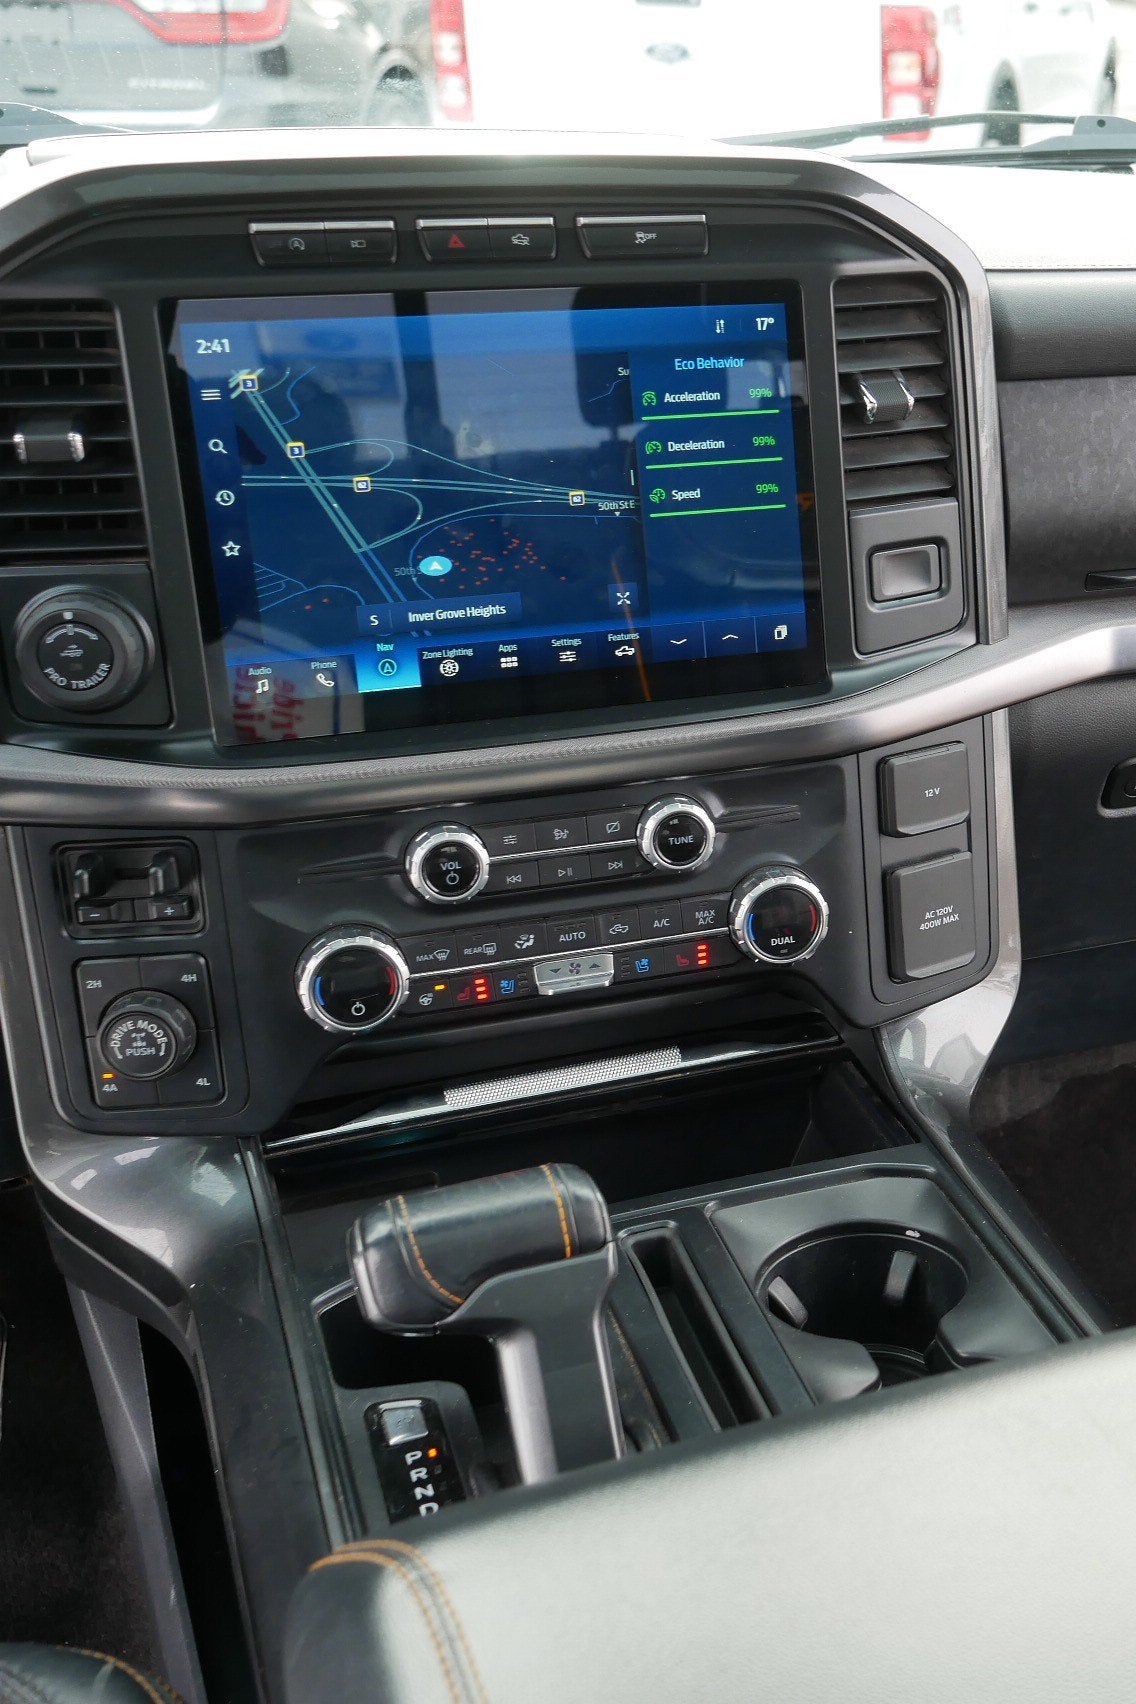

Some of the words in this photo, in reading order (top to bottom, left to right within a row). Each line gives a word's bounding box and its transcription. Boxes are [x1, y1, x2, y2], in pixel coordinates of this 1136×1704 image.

[195, 338, 231, 354] 2:41
[673, 358, 695, 370] Eco
[696, 356, 745, 370] Behavior
[663, 390, 721, 403] Acceleration
[749, 388, 773, 399] 99%
[667, 439, 726, 452] Deceleration
[752, 436, 777, 447] 99%
[756, 483, 779, 494] 99%
[672, 488, 701, 502] Speed
[598, 501, 618, 511] 50th
[619, 500, 630, 510] St
[630, 500, 636, 509] E
[394, 566, 416, 576] 50th
[408, 611, 435, 622] Inver
[435, 608, 466, 620] Grove
[466, 604, 507, 618] Heights
[370, 614, 379, 626] S
[551, 636, 582, 648] Settings
[607, 631, 640, 642] Features
[376, 643, 395, 652] Nav
[498, 644, 518, 654] Apps
[422, 650, 442, 660] Zone
[443, 647, 474, 658] Lighting
[310, 660, 338, 670] Phone
[44, 667, 67, 686] PRO
[70, 663, 111, 689] TRAILER
[248, 667, 273, 677] Audio
[924, 788, 934, 798] 12
[934, 787, 941, 796] V
[668, 834, 695, 846] TUNE
[440, 861, 462, 871] VOL
[695, 909, 716, 919] MAX
[924, 910, 936, 920] AC
[936, 904, 954, 917] 120V
[653, 918, 671, 929] A/C
[698, 916, 715, 926] A/C
[919, 919, 942, 931] 400W
[942, 912, 960, 924] MAX
[558, 930, 587, 942] AUTO
[770, 935, 796, 947] DUAL
[464, 946, 483, 956] REAR
[416, 954, 435, 963] MAX
[181, 973, 197, 983] 4H
[86, 980, 102, 990] 2H
[110, 1021, 135, 1047] DRIVE
[137, 1020, 168, 1044] MODE
[125, 1047, 157, 1058] PUSH
[195, 1077, 212, 1087] 4L
[102, 1084, 119, 1093] 4A
[405, 1450, 422, 1465] P
[410, 1467, 428, 1482] R
[414, 1483, 435, 1501] N
